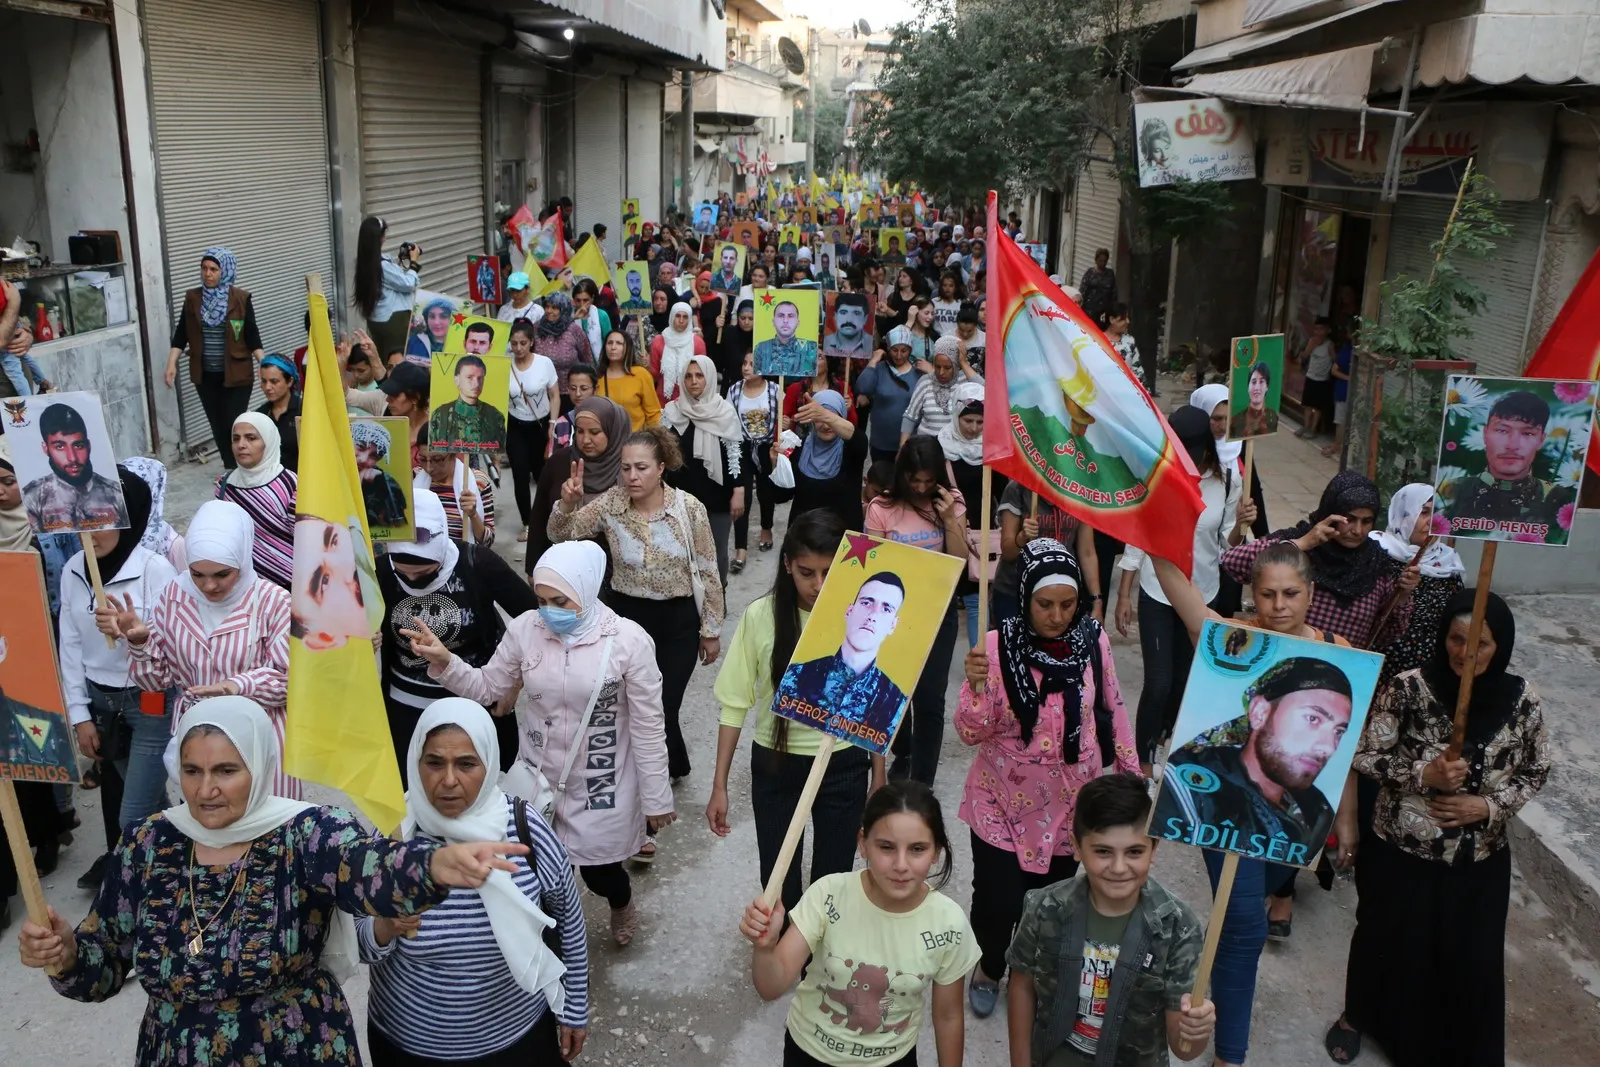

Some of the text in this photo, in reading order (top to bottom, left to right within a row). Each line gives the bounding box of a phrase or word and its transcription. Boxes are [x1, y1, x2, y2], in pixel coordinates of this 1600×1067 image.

[1010, 413, 1047, 470] MECLISA
[1045, 467, 1112, 504] MALBATÊN
[1451, 517, 1549, 536] ŞEHÎD HENEŞ
[920, 929, 962, 950] Bears
[813, 1022, 846, 1053] Free
